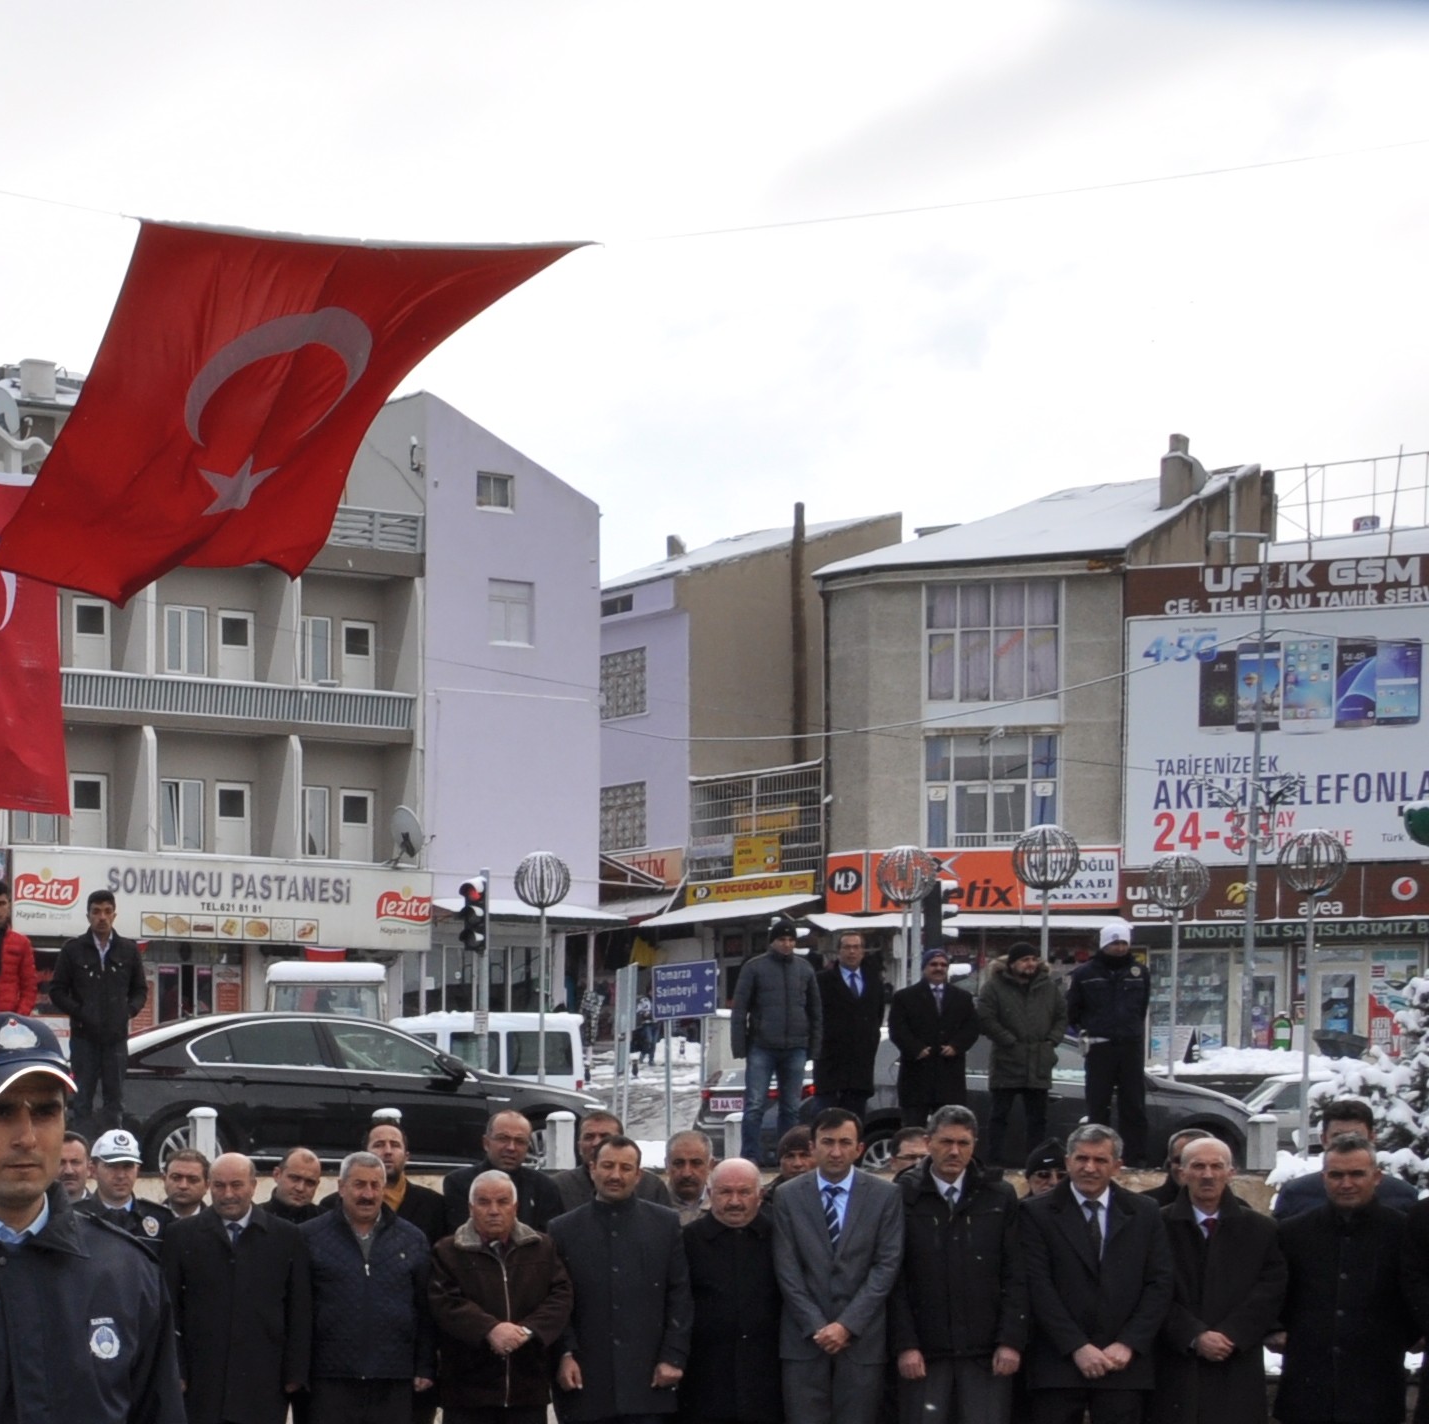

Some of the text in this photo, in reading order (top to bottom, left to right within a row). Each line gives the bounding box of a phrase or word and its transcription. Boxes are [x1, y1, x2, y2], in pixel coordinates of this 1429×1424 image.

[1328, 557, 1421, 587] GSM
[1259, 756, 1279, 773] EK
[1276, 811, 1296, 829] AY
[16, 876, 74, 902] lezita
[107, 867, 351, 905] SOMUNCU PASTANESİ
[252, 904, 262, 913] 81
[381, 896, 430, 917] lezita
[1297, 901, 1343, 916] avea
[656, 969, 692, 981] Tomarza
[656, 982, 698, 998] Saimbeyli
